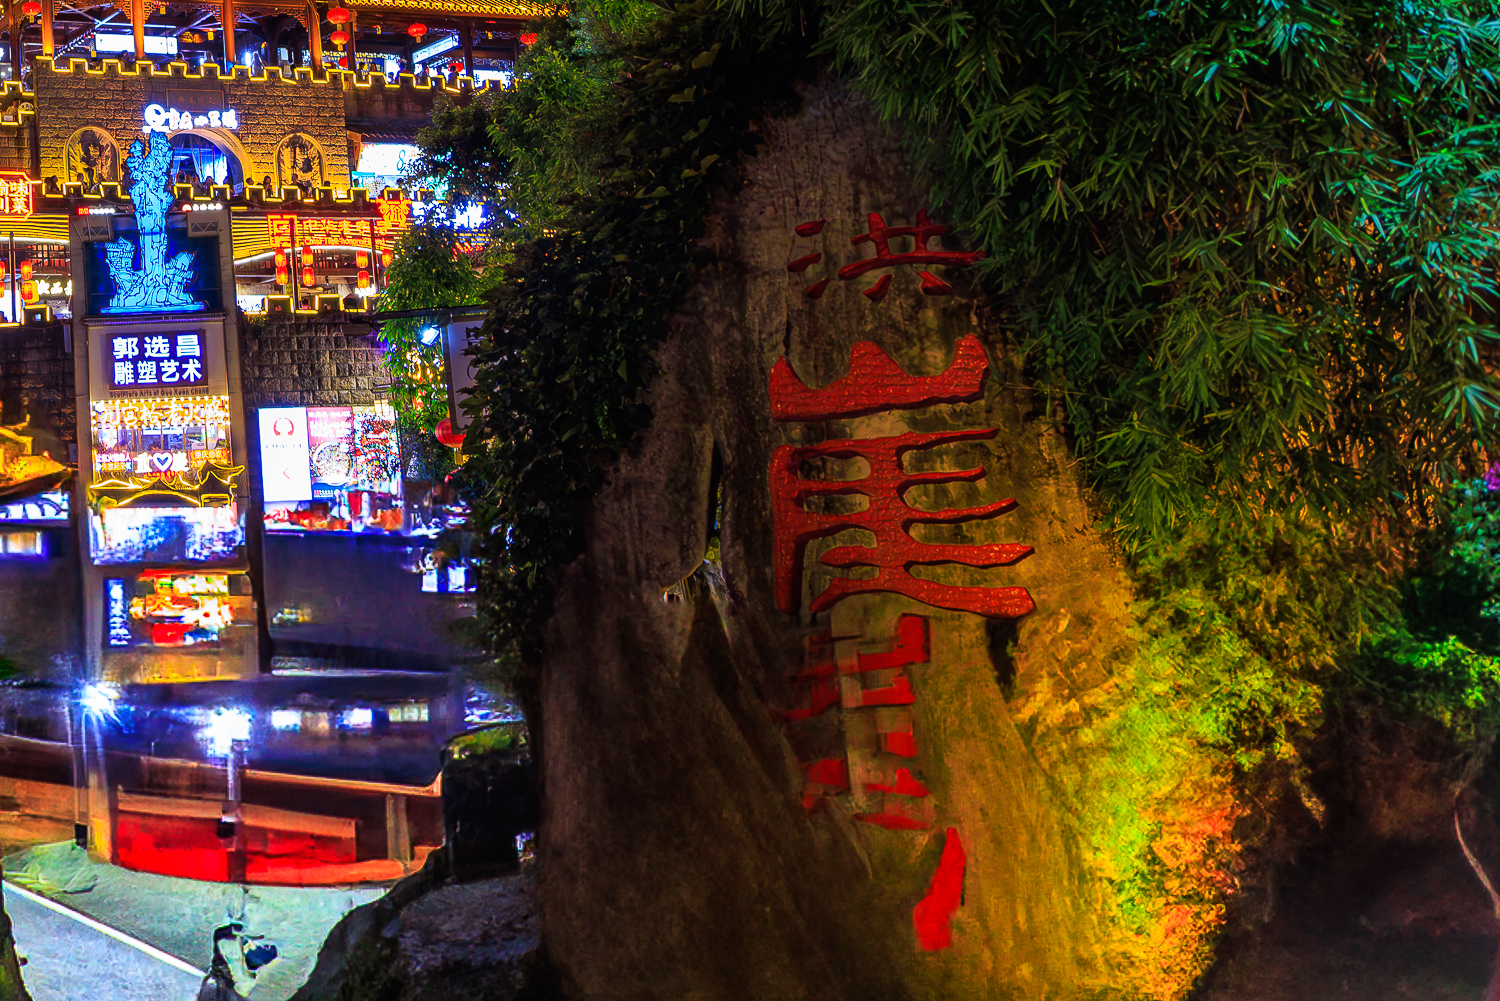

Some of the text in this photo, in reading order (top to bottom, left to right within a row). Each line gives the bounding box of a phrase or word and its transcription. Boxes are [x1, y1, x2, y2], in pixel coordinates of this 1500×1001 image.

[112, 335, 201, 360] 郭选昌
[113, 358, 203, 385] 雕塑艺术
